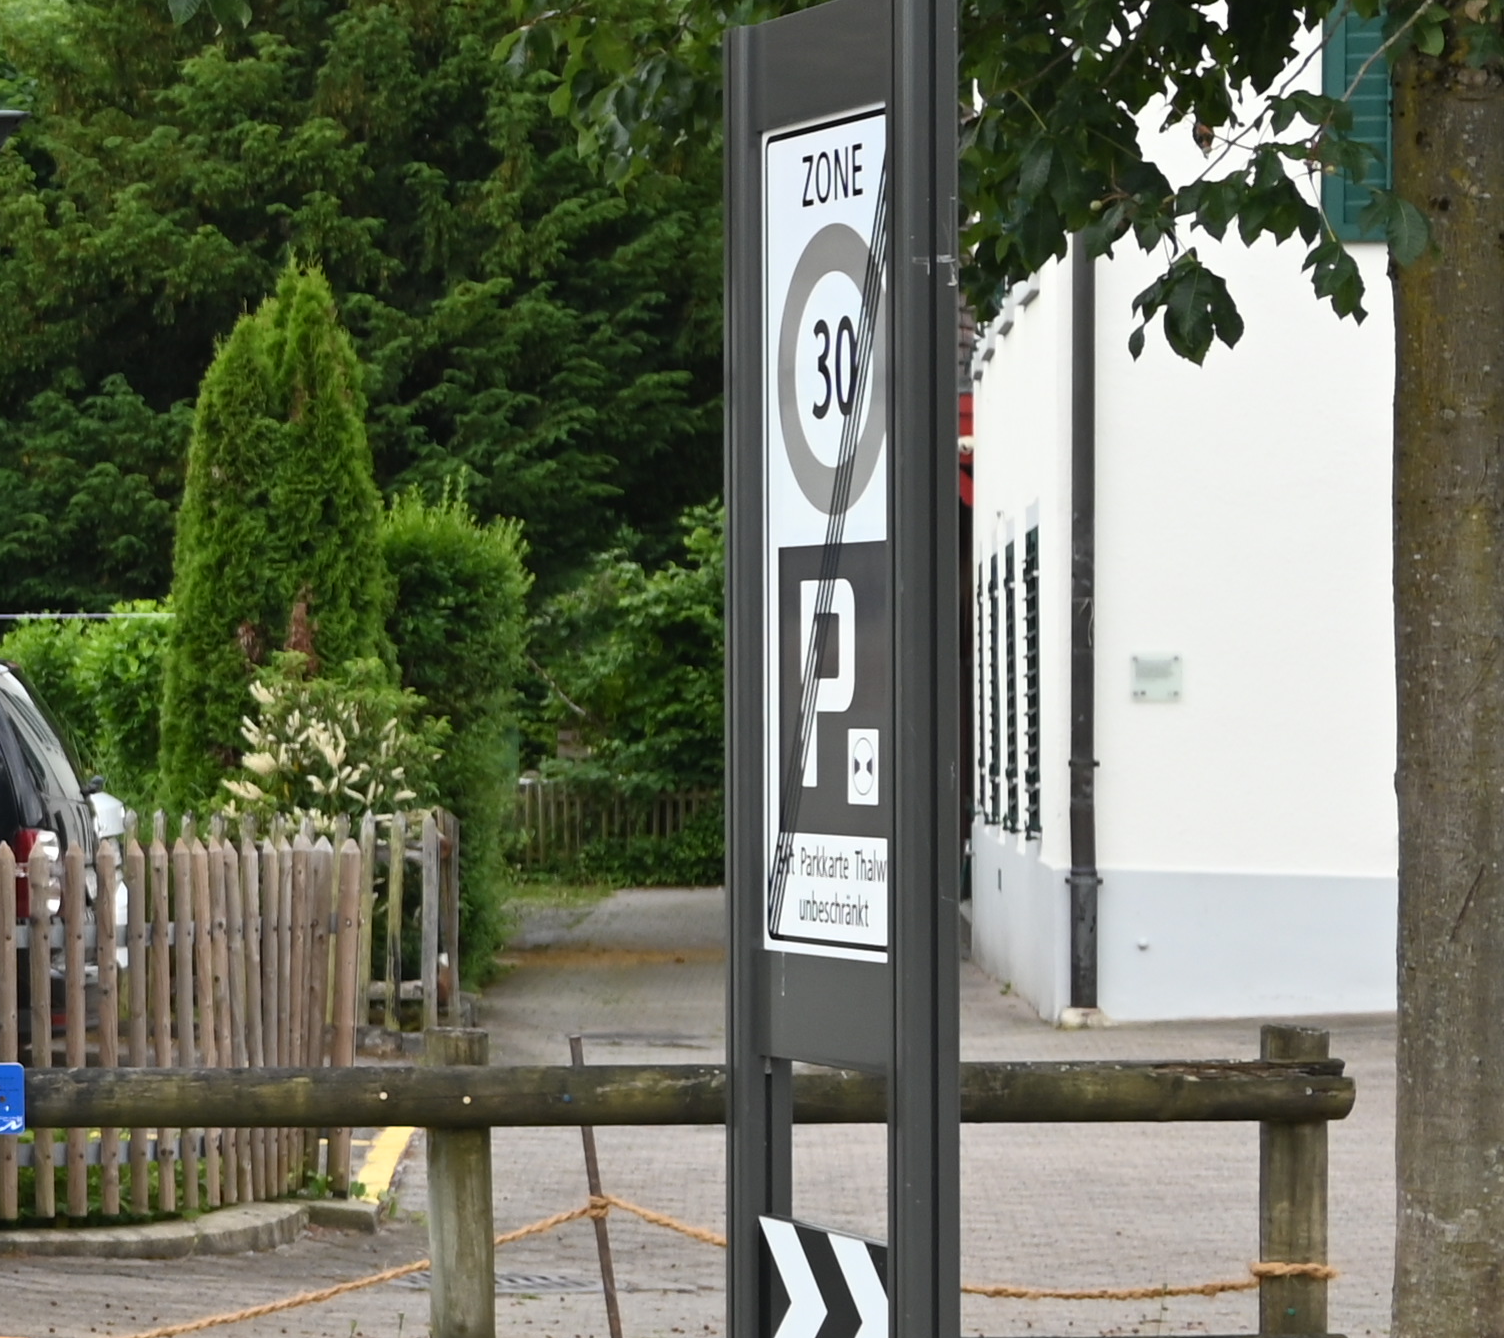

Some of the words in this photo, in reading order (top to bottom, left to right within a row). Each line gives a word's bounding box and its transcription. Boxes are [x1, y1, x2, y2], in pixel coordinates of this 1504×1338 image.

[802, 143, 863, 207] ZONE
[812, 315, 859, 419] 30
[800, 578, 855, 787] P
[801, 846, 849, 879] Parkkarte
[799, 890, 869, 927] unbeschränkt
